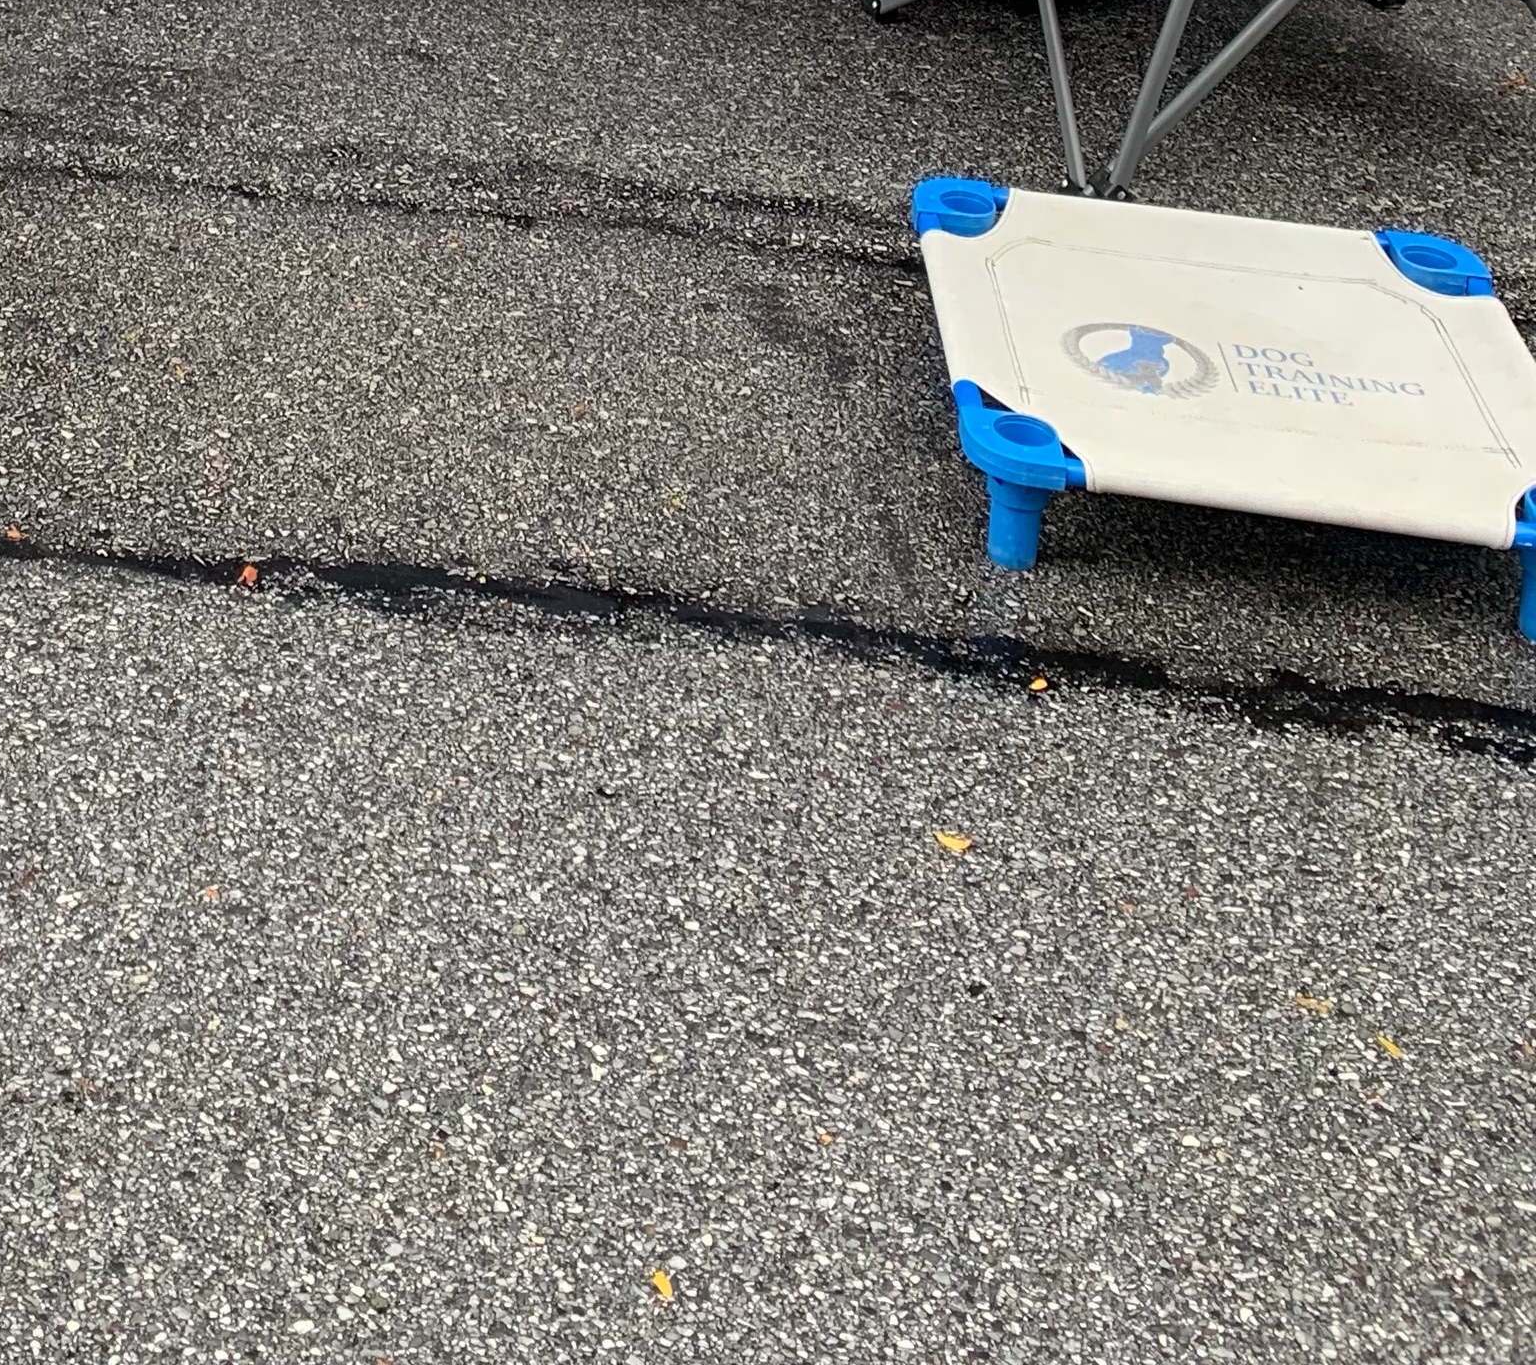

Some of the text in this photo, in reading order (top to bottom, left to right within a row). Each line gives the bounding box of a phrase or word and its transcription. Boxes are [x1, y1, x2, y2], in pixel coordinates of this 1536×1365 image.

[1231, 343, 1315, 368] DOG
[1237, 361, 1425, 397] TRAINING
[1249, 380, 1355, 406] ELITE
